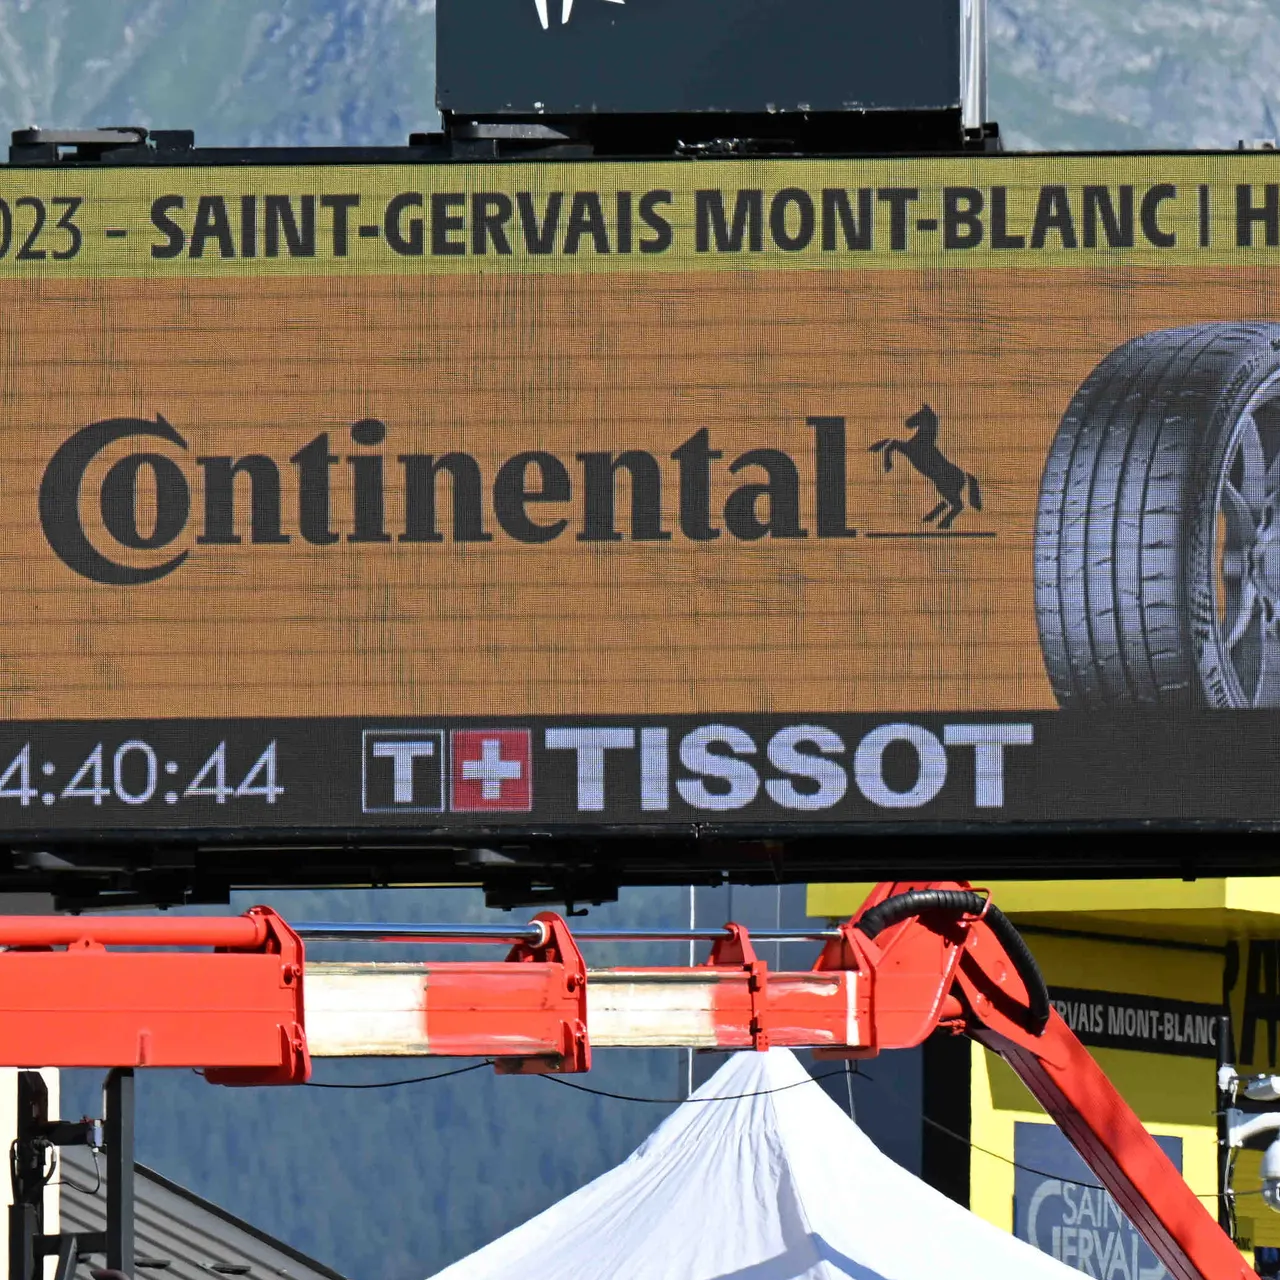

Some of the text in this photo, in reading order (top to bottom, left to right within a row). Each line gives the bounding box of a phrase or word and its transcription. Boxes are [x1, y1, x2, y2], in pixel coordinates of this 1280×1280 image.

[151, 188, 672, 258] SAINT-GERVAIS
[696, 184, 1175, 253] MONT-BLANC
[38, 413, 856, 586] Continental
[544, 724, 1034, 811] TISSOT
[1108, 1006, 1217, 1046] MONT-BLANC
[1062, 1182, 1134, 1230] SAIN
